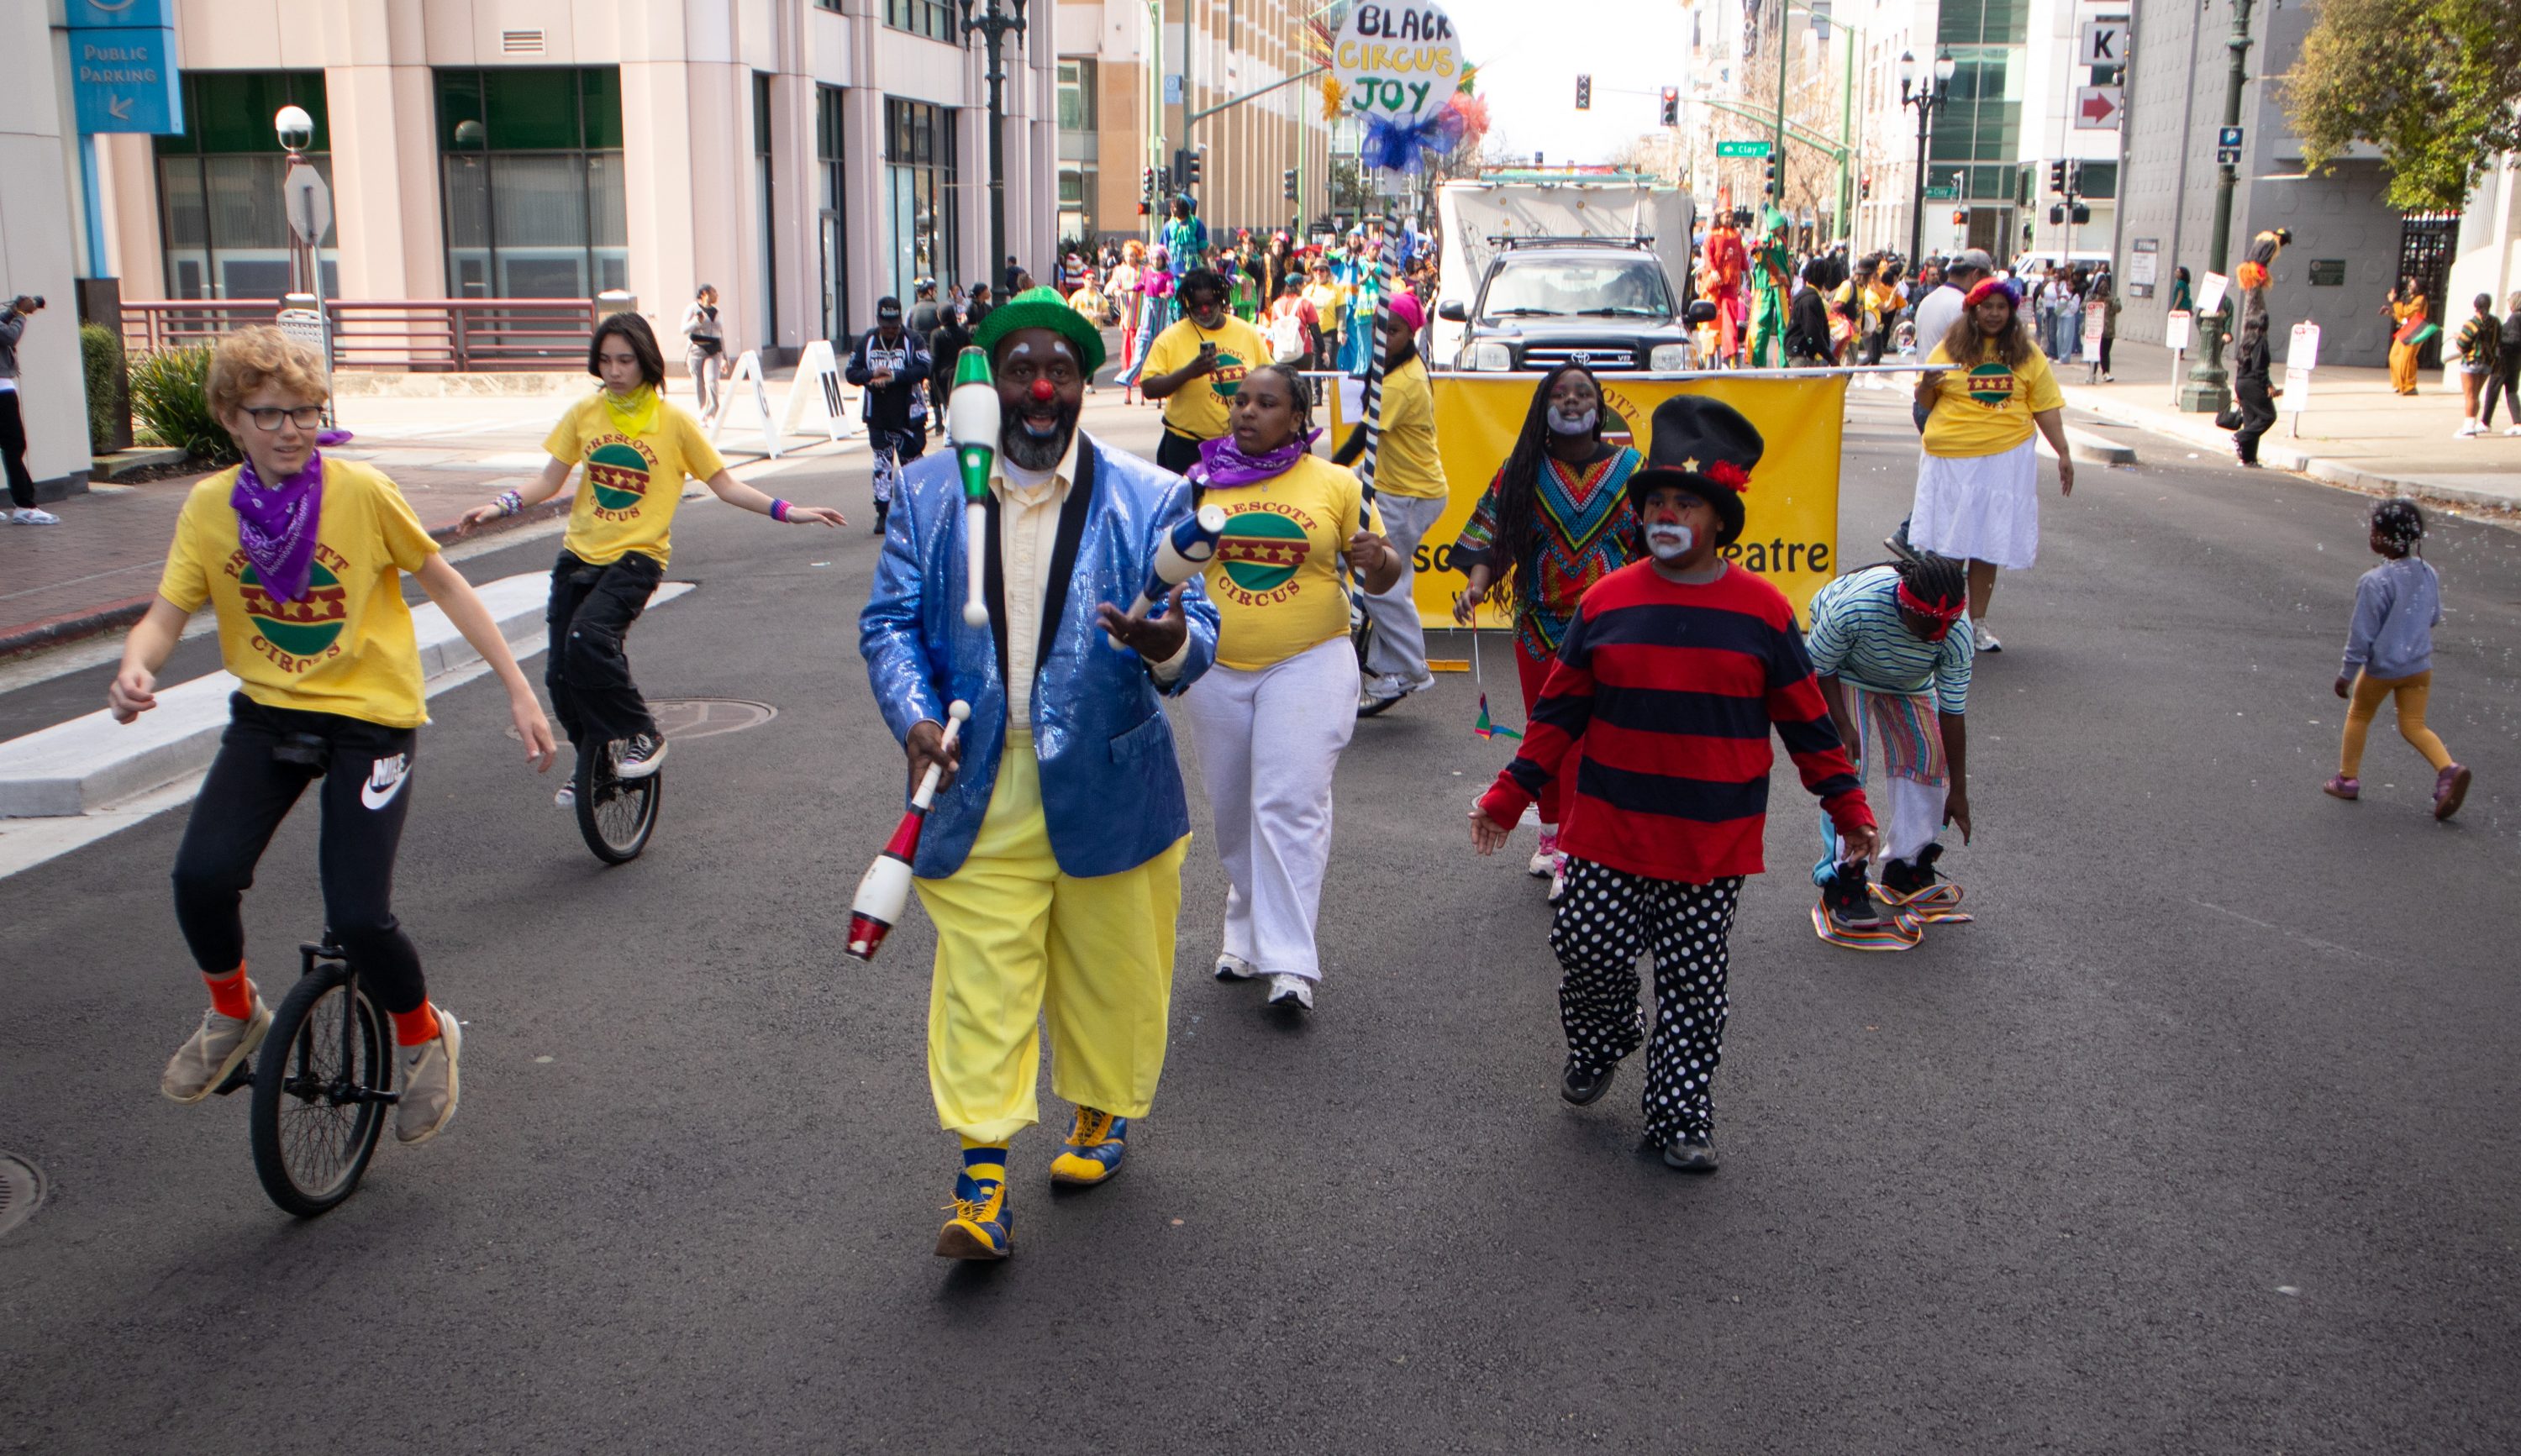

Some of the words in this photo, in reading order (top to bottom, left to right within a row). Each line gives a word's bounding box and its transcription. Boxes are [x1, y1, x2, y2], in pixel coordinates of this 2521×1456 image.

[1357, 5, 1452, 41] BLACK
[84, 45, 148, 60] PUBLIC
[1338, 40, 1455, 77] CIRCUS
[2093, 30, 2114, 58] K
[80, 66, 156, 82] PARKING
[1351, 76, 1430, 113] JOY
[1738, 145, 1757, 157] Clay
[1934, 187, 1949, 197] Clay
[821, 371, 845, 418] M
[590, 496, 640, 522] CRCUS
[1222, 502, 1318, 531] RESCOTT
[224, 543, 350, 580] PRTT
[1714, 538, 1829, 573] eatre
[1218, 576, 1300, 607] CIRCUS
[251, 635, 340, 673] CIRCS
[371, 753, 404, 786] NIKE
